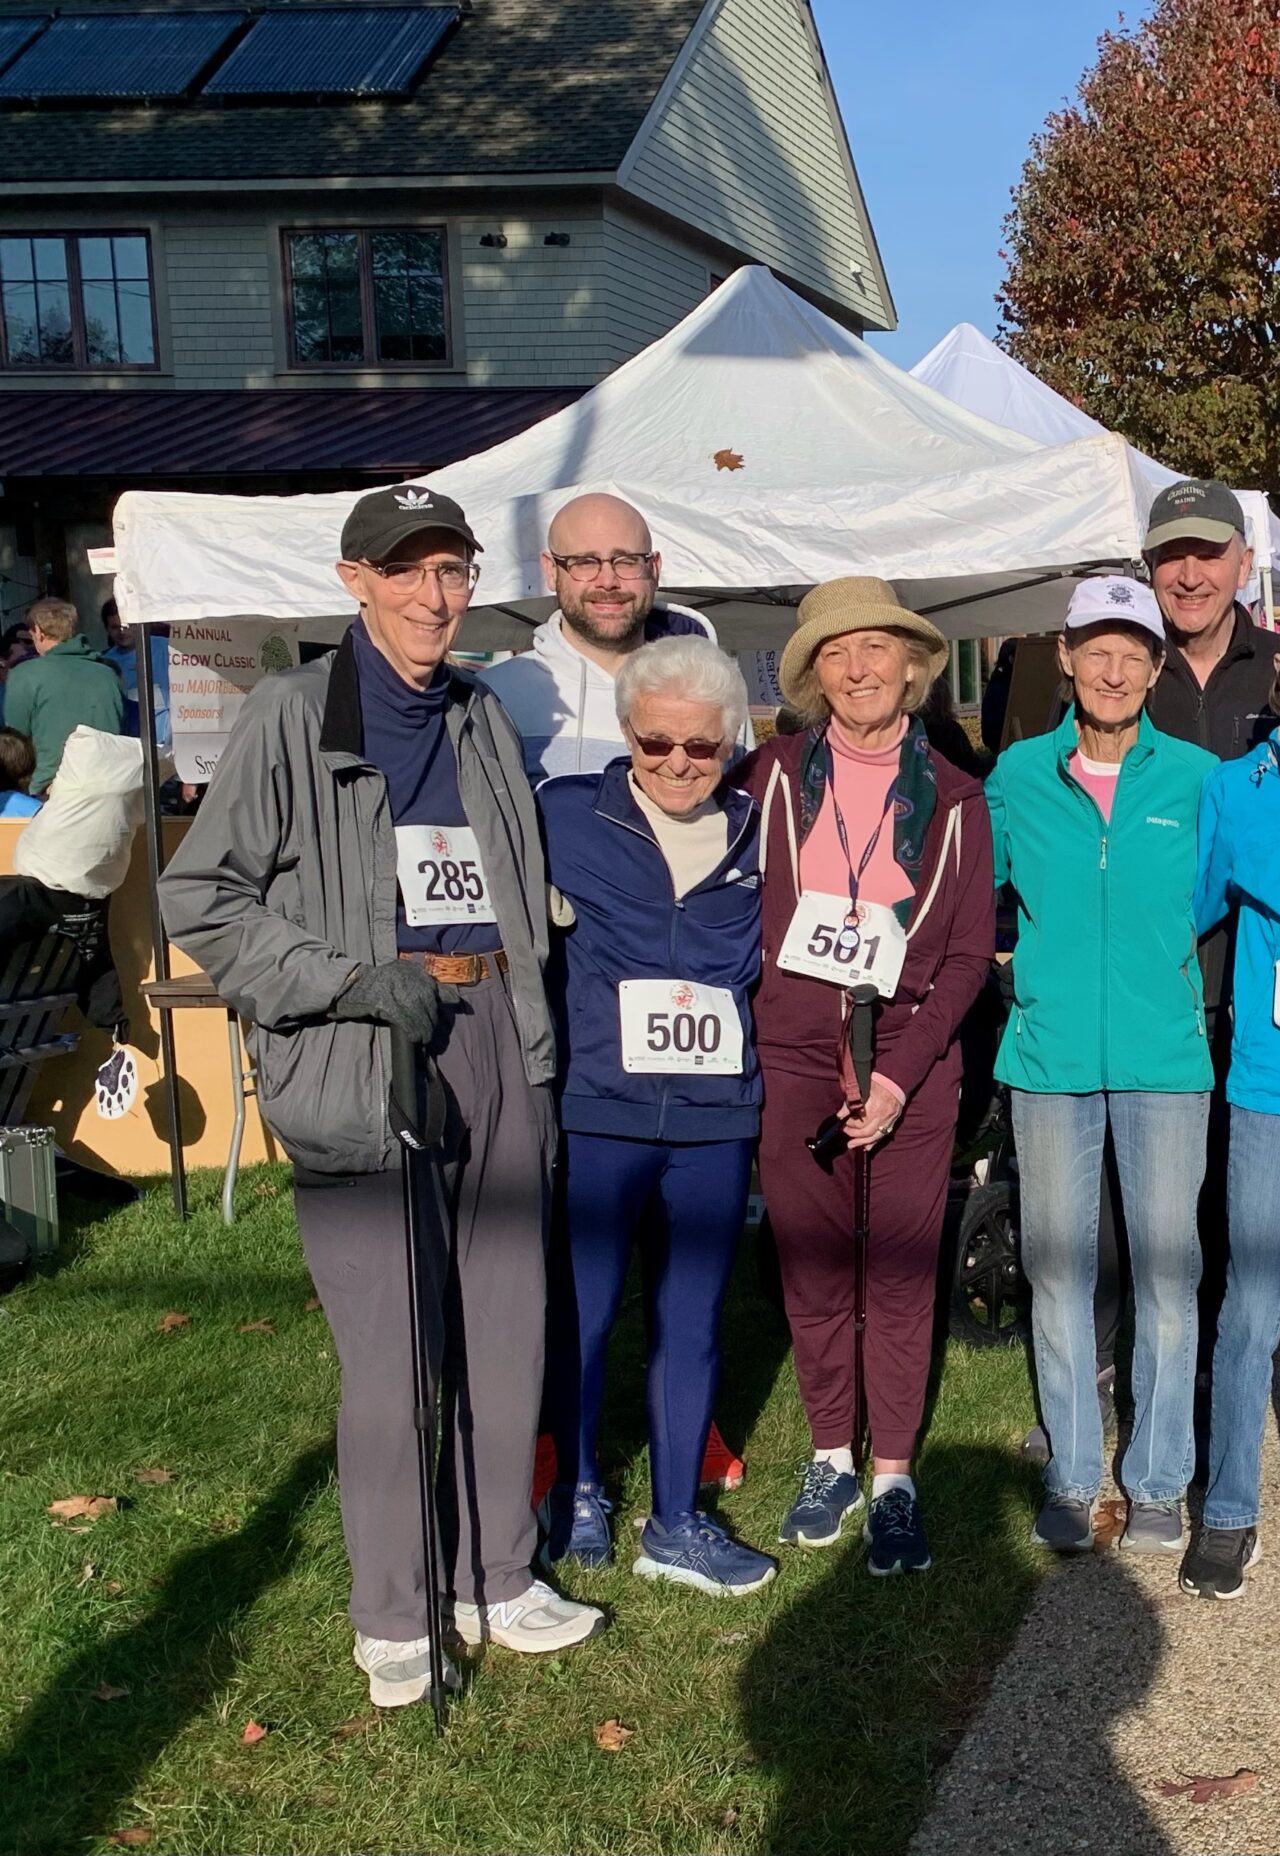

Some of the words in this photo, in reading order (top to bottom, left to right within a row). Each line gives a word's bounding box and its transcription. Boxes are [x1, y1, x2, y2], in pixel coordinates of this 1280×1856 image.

[171, 627, 181, 638] H
[214, 652, 256, 668] CLASSIC
[170, 682, 184, 693] ou
[177, 705, 224, 722] Sponsors!
[418, 860, 484, 901] 285
[807, 924, 881, 970] 501
[647, 1013, 722, 1054] 500
